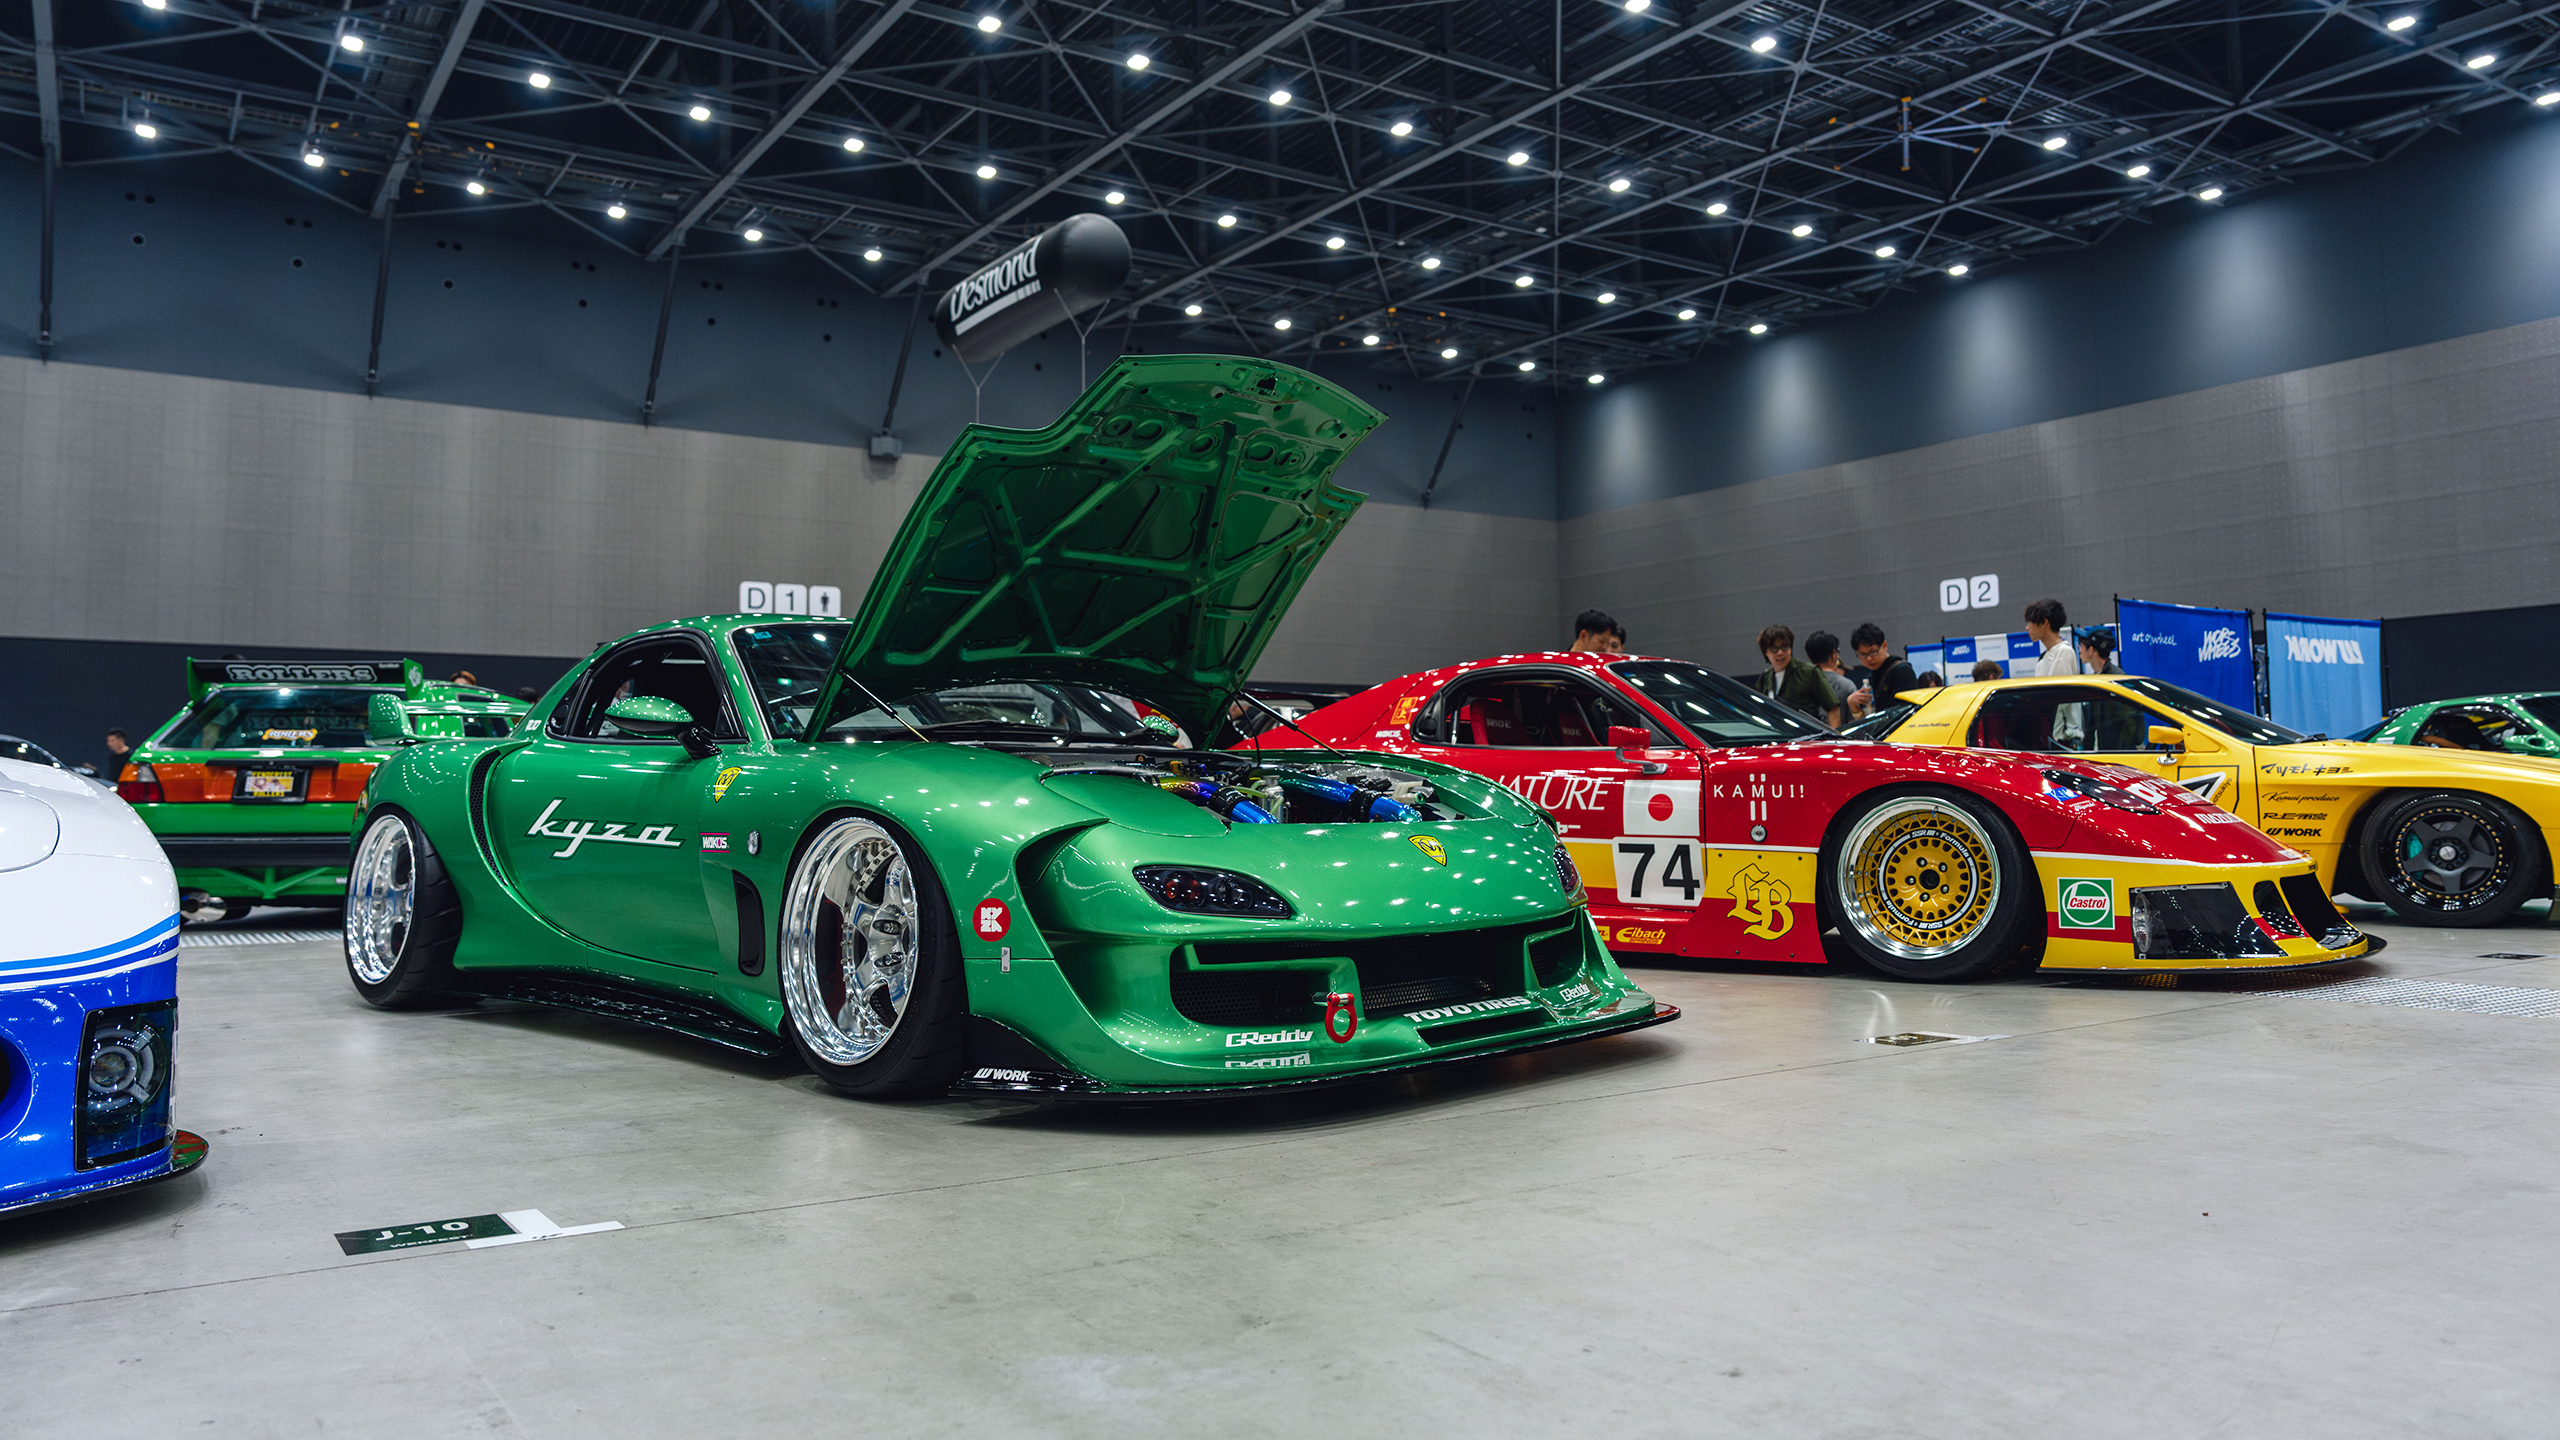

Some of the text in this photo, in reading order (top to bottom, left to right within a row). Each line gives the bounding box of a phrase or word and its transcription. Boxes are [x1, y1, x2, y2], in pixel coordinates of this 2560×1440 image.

[748, 587, 766, 609] D
[1946, 580, 1992, 606] D 2
[229, 666, 376, 682] ROLLERS
[267, 730, 314, 740] ROLLERS
[2261, 763, 2354, 777] マツモトキヨシ
[2262, 791, 2340, 804] Kamui produce
[526, 798, 686, 858] kyza
[2284, 828, 2322, 837] WORK
[1940, 832, 1970, 858] Formula
[1618, 843, 1701, 901] 74
[2069, 897, 2107, 909] Castrol
[1885, 900, 1914, 926] Formula
[1616, 927, 1667, 943] Eibach
[1559, 983, 1591, 1002] GReddy
[1403, 995, 1533, 1023] TOYO TIRES
[1225, 1029, 1314, 1048] GReddy
[992, 1068, 1031, 1082] WORK
[375, 1221, 470, 1241] J-10
